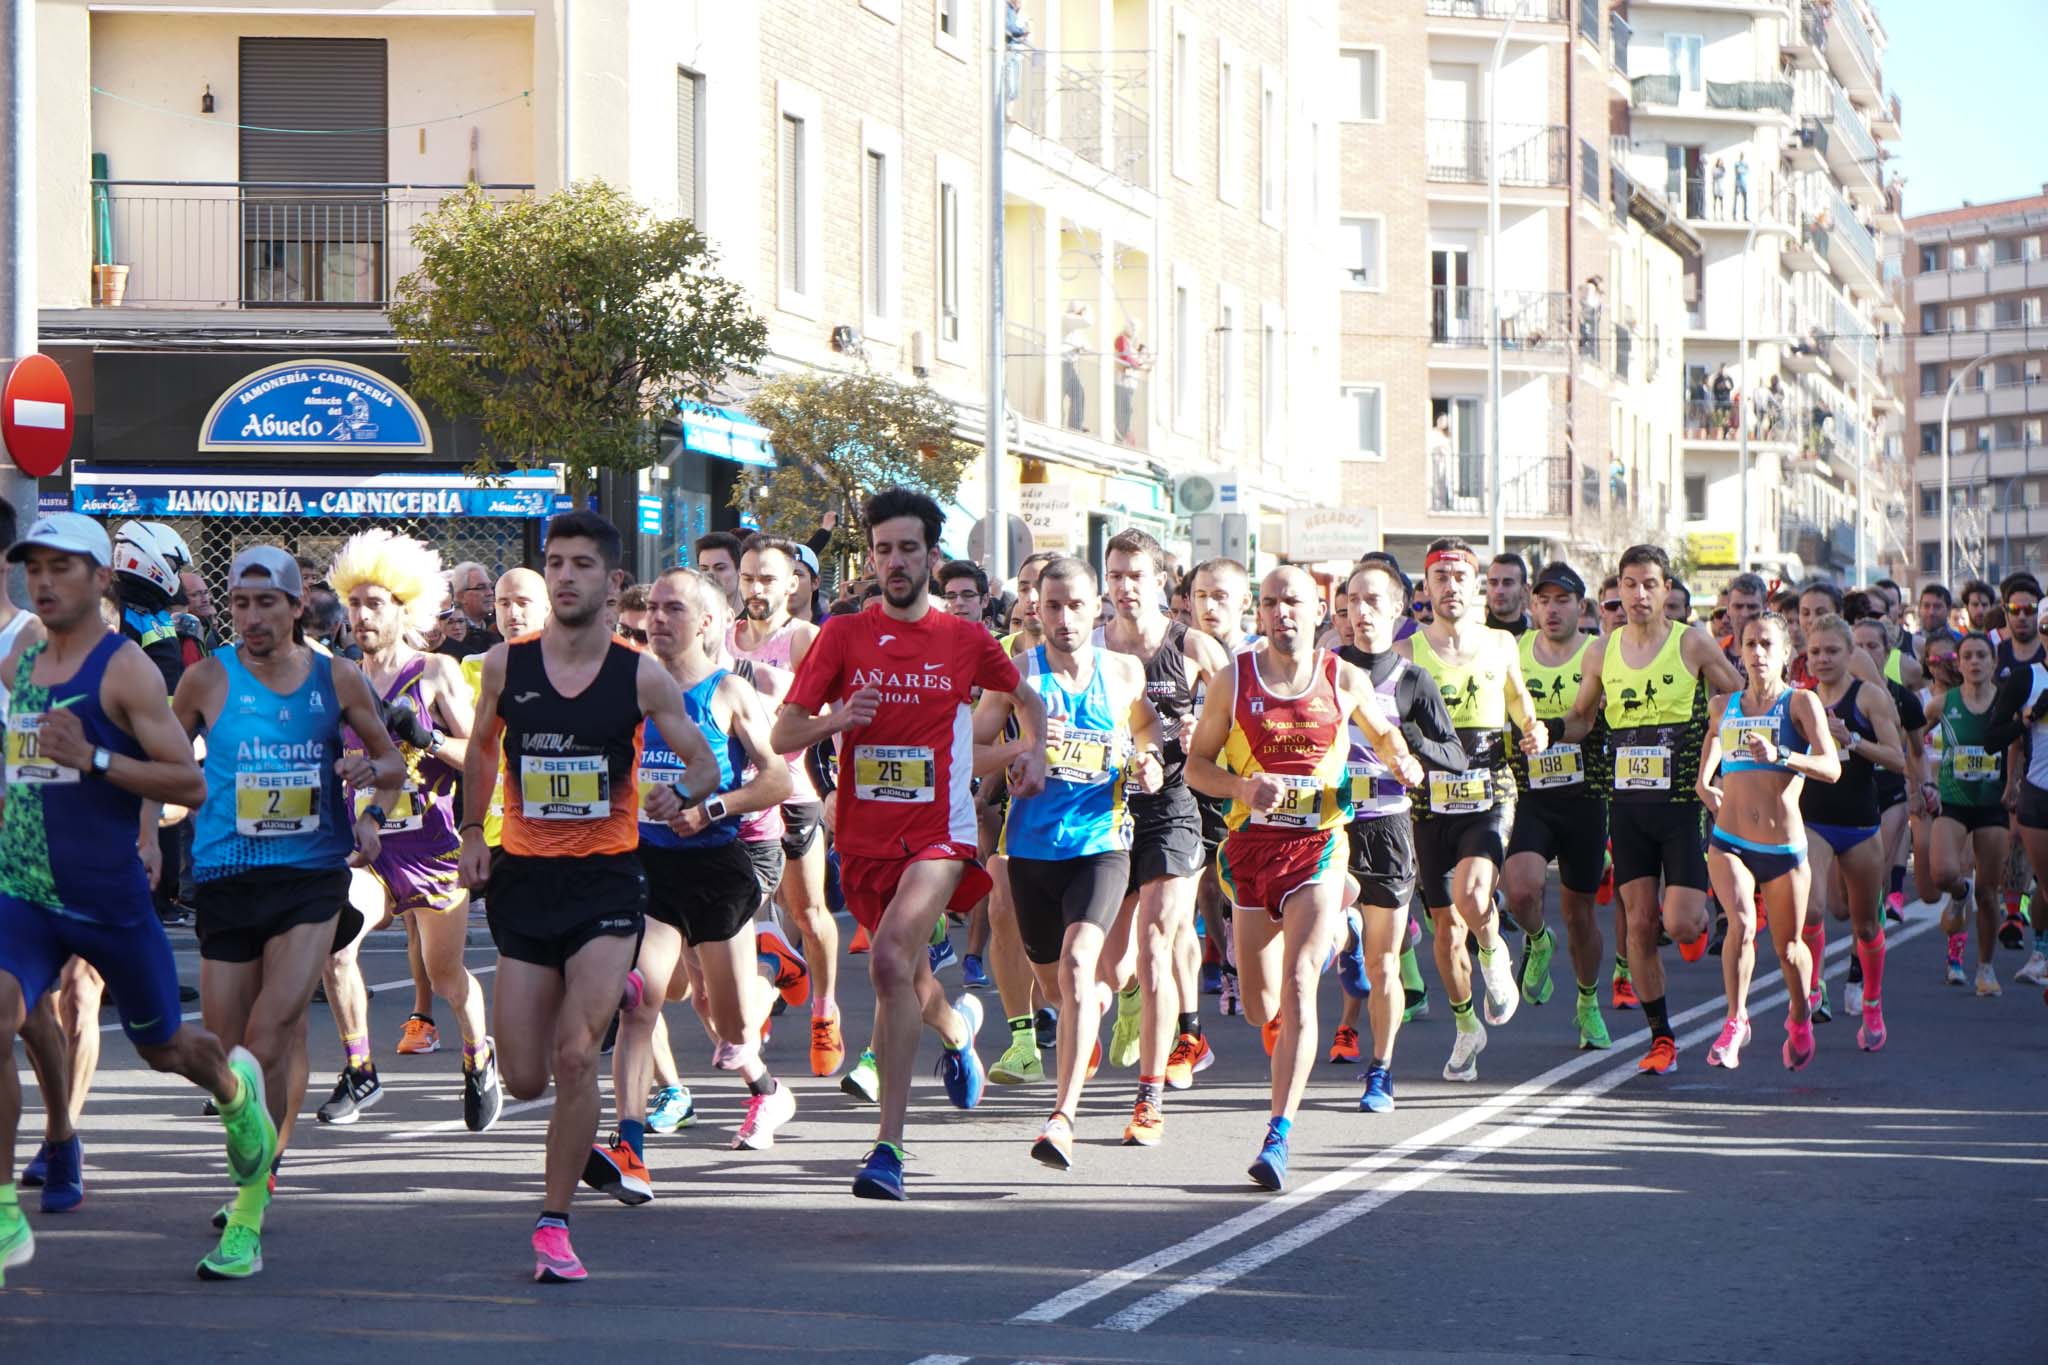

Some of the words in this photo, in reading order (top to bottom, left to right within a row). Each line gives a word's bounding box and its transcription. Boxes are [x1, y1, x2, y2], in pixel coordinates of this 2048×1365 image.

[238, 370, 309, 405] JAMONERÍA
[318, 372, 394, 407] CARNICERÍA
[240, 413, 323, 437] Abuelo
[81, 498, 118, 511] Abuelo
[166, 488, 304, 513] JAMONERÍA
[320, 489, 464, 514] CARNICERÍA
[488, 500, 526, 512] Abuelo
[850, 667, 952, 692] AÑARES
[237, 735, 324, 761] Alicante
[1274, 735, 1306, 744] VINO
[875, 748, 927, 758] SETEL
[1062, 741, 1083, 762] 74
[1263, 745, 1280, 754] DE
[544, 761, 600, 771] SETEL
[877, 761, 902, 782] 26
[1539, 755, 1563, 774] 198
[1629, 758, 1649, 774] 143
[259, 775, 313, 787] SETEL
[549, 774, 570, 798] 10
[1446, 782, 1470, 799] 145
[268, 789, 281, 814] 2
